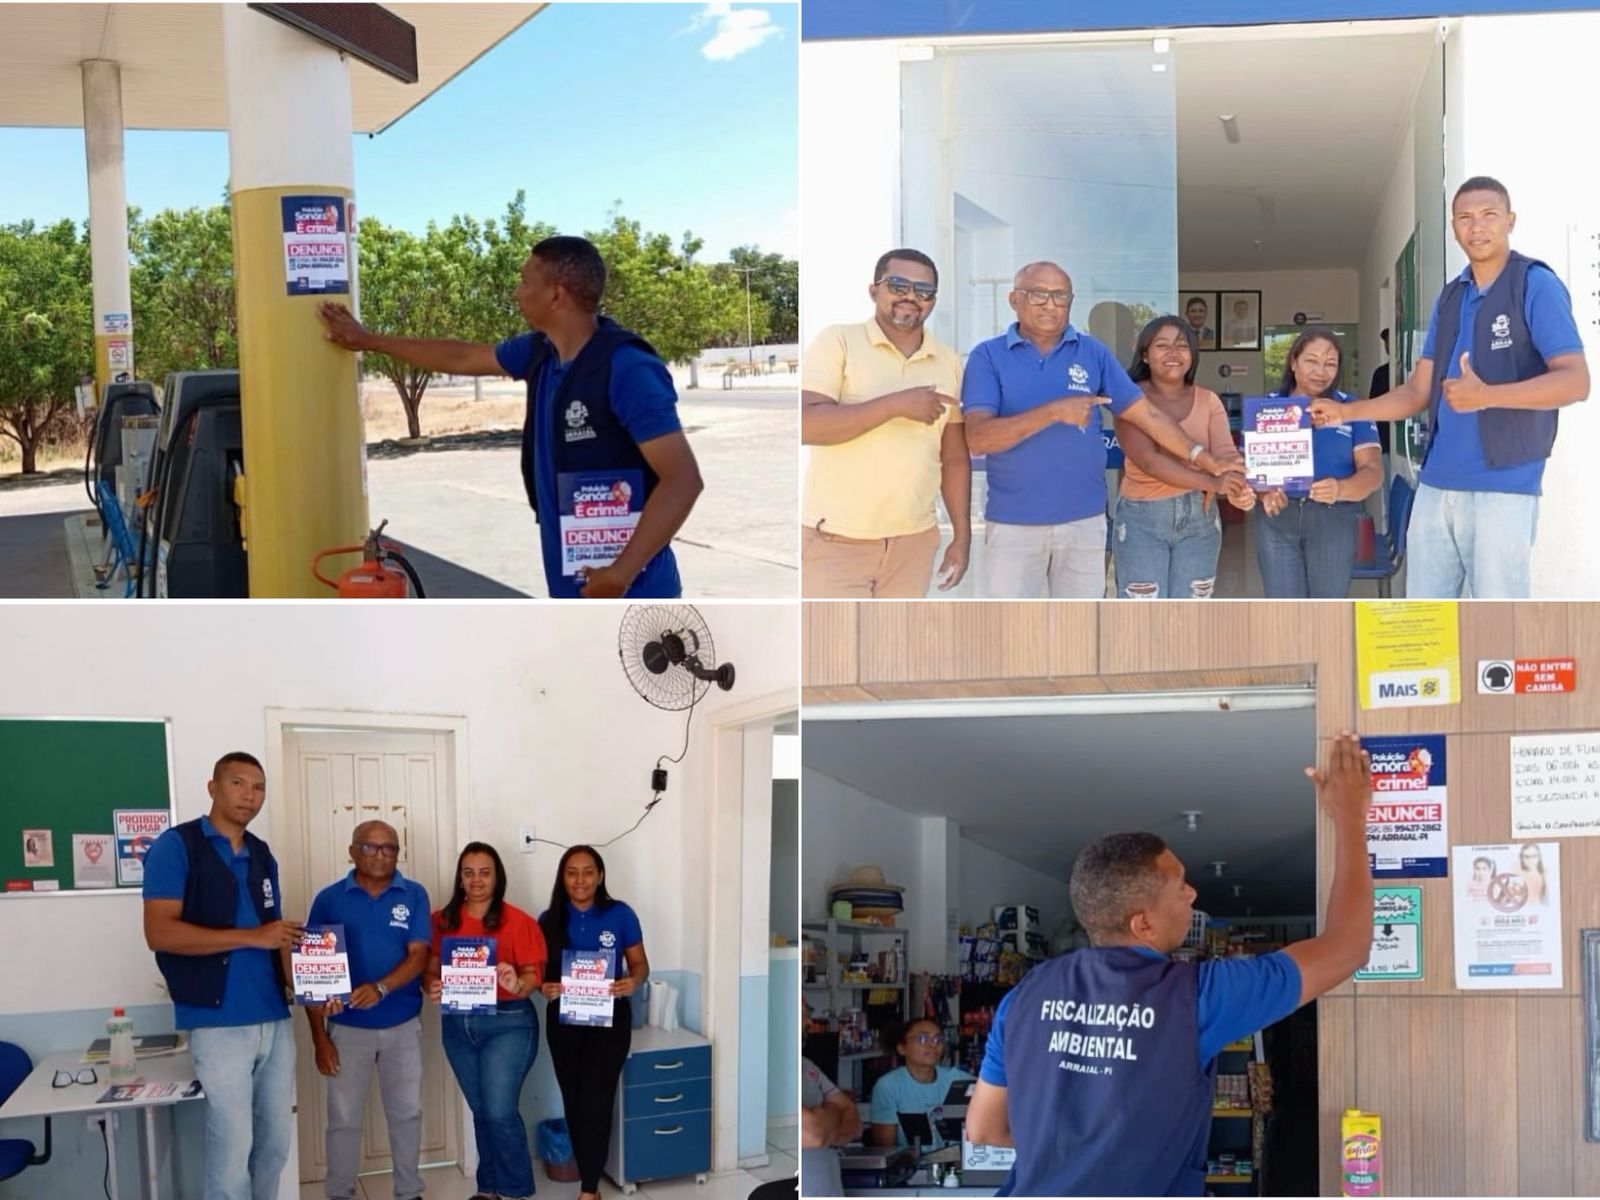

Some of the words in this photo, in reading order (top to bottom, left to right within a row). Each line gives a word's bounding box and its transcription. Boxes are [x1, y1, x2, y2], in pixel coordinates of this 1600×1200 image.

[290, 244, 343, 255] DENUNCIE
[1249, 441, 1309, 454] DENUNCIE
[575, 502, 585, 517] É
[586, 502, 629, 516] crime!
[1516, 662, 1537, 672] NÃO
[1540, 662, 1574, 671] ENTRE
[1534, 673, 1555, 682] SEM
[1525, 683, 1564, 692] CAMISA
[1372, 752, 1406, 762] Poluição
[1376, 774, 1428, 791] crime!
[1366, 805, 1439, 821] ENUNCIE
[119, 814, 168, 824] PROIBIDO
[127, 824, 161, 832] FUMAR
[1366, 834, 1381, 842] PM
[296, 964, 345, 973] DENUNCIE
[445, 976, 494, 984] DENUNCIE
[1041, 1000, 1155, 1031] FISCALIZAÇÃO
[1049, 1031, 1137, 1060] AMBIENTAL
[1059, 1060, 1098, 1075] ARRAIAL
[1104, 1067, 1113, 1076] PI
